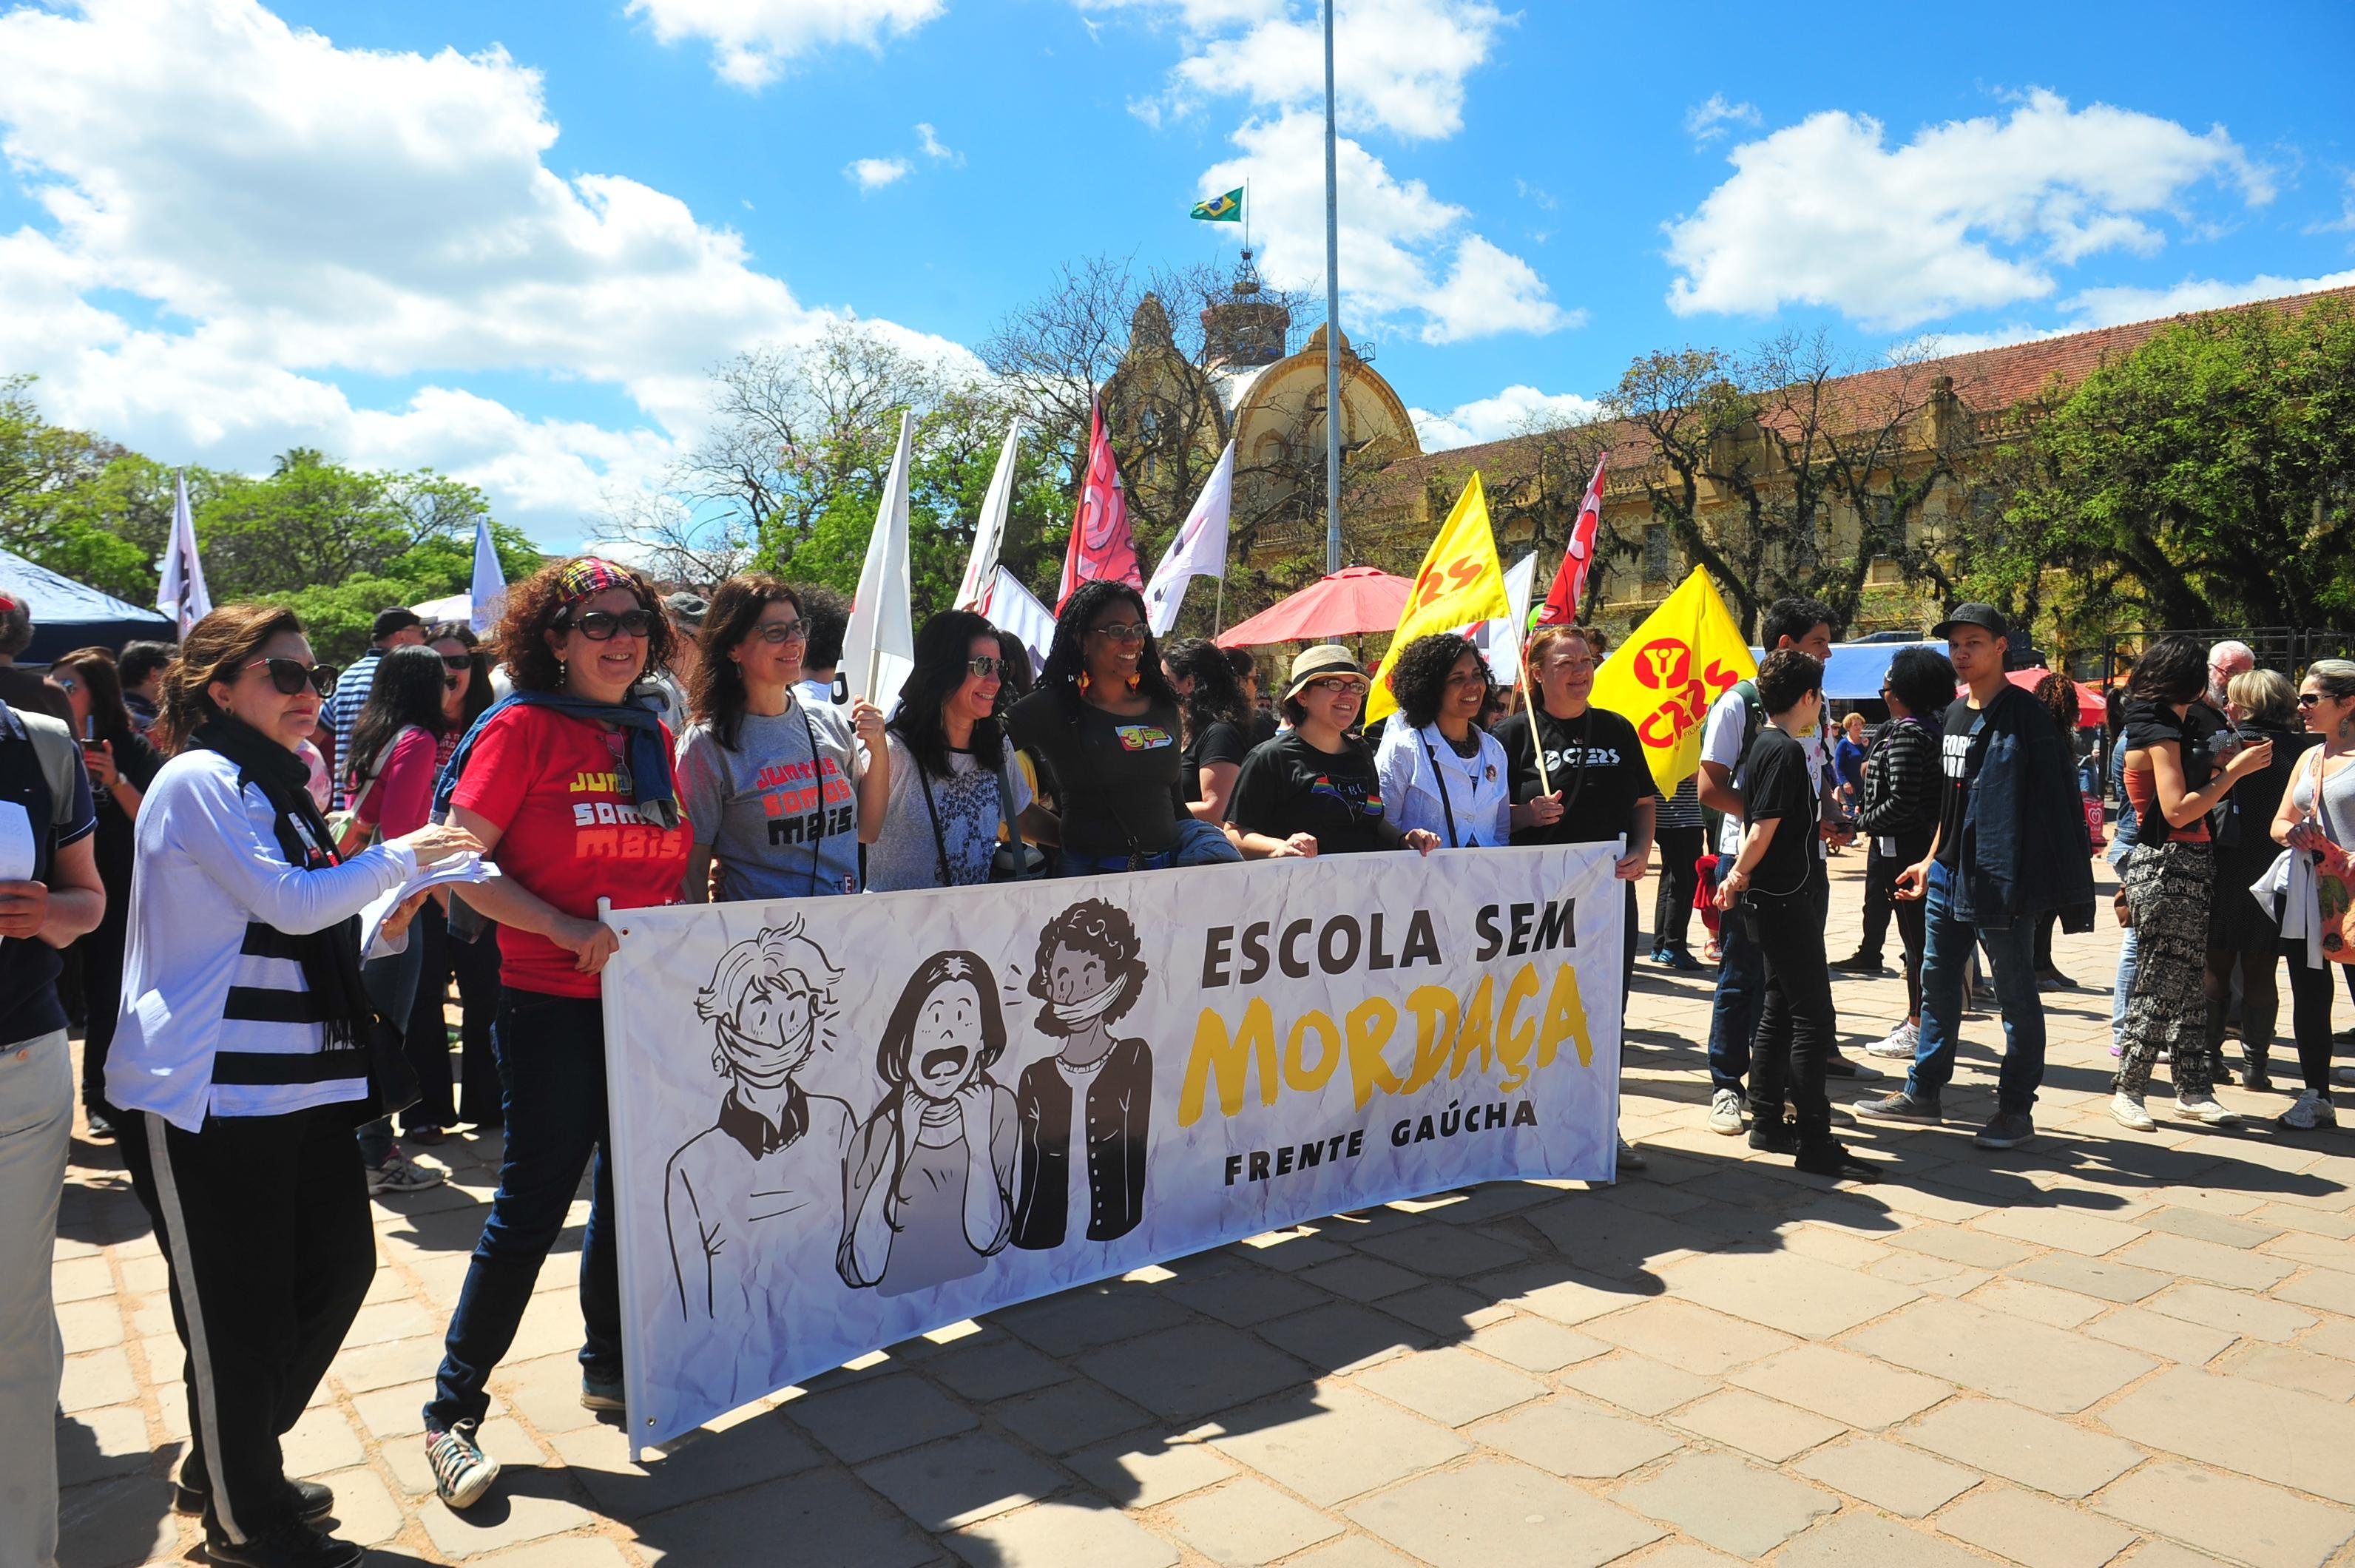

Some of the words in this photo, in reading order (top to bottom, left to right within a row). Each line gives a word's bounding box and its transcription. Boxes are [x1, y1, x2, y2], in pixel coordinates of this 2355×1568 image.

[1201, 909, 1442, 989] ESCOLA
[1476, 897, 1577, 962] SEM
[1178, 962, 1593, 1128] MORDAÇA
[1224, 1129, 1364, 1186] FRENTE
[1391, 1099, 1538, 1147] GAÚCHA
